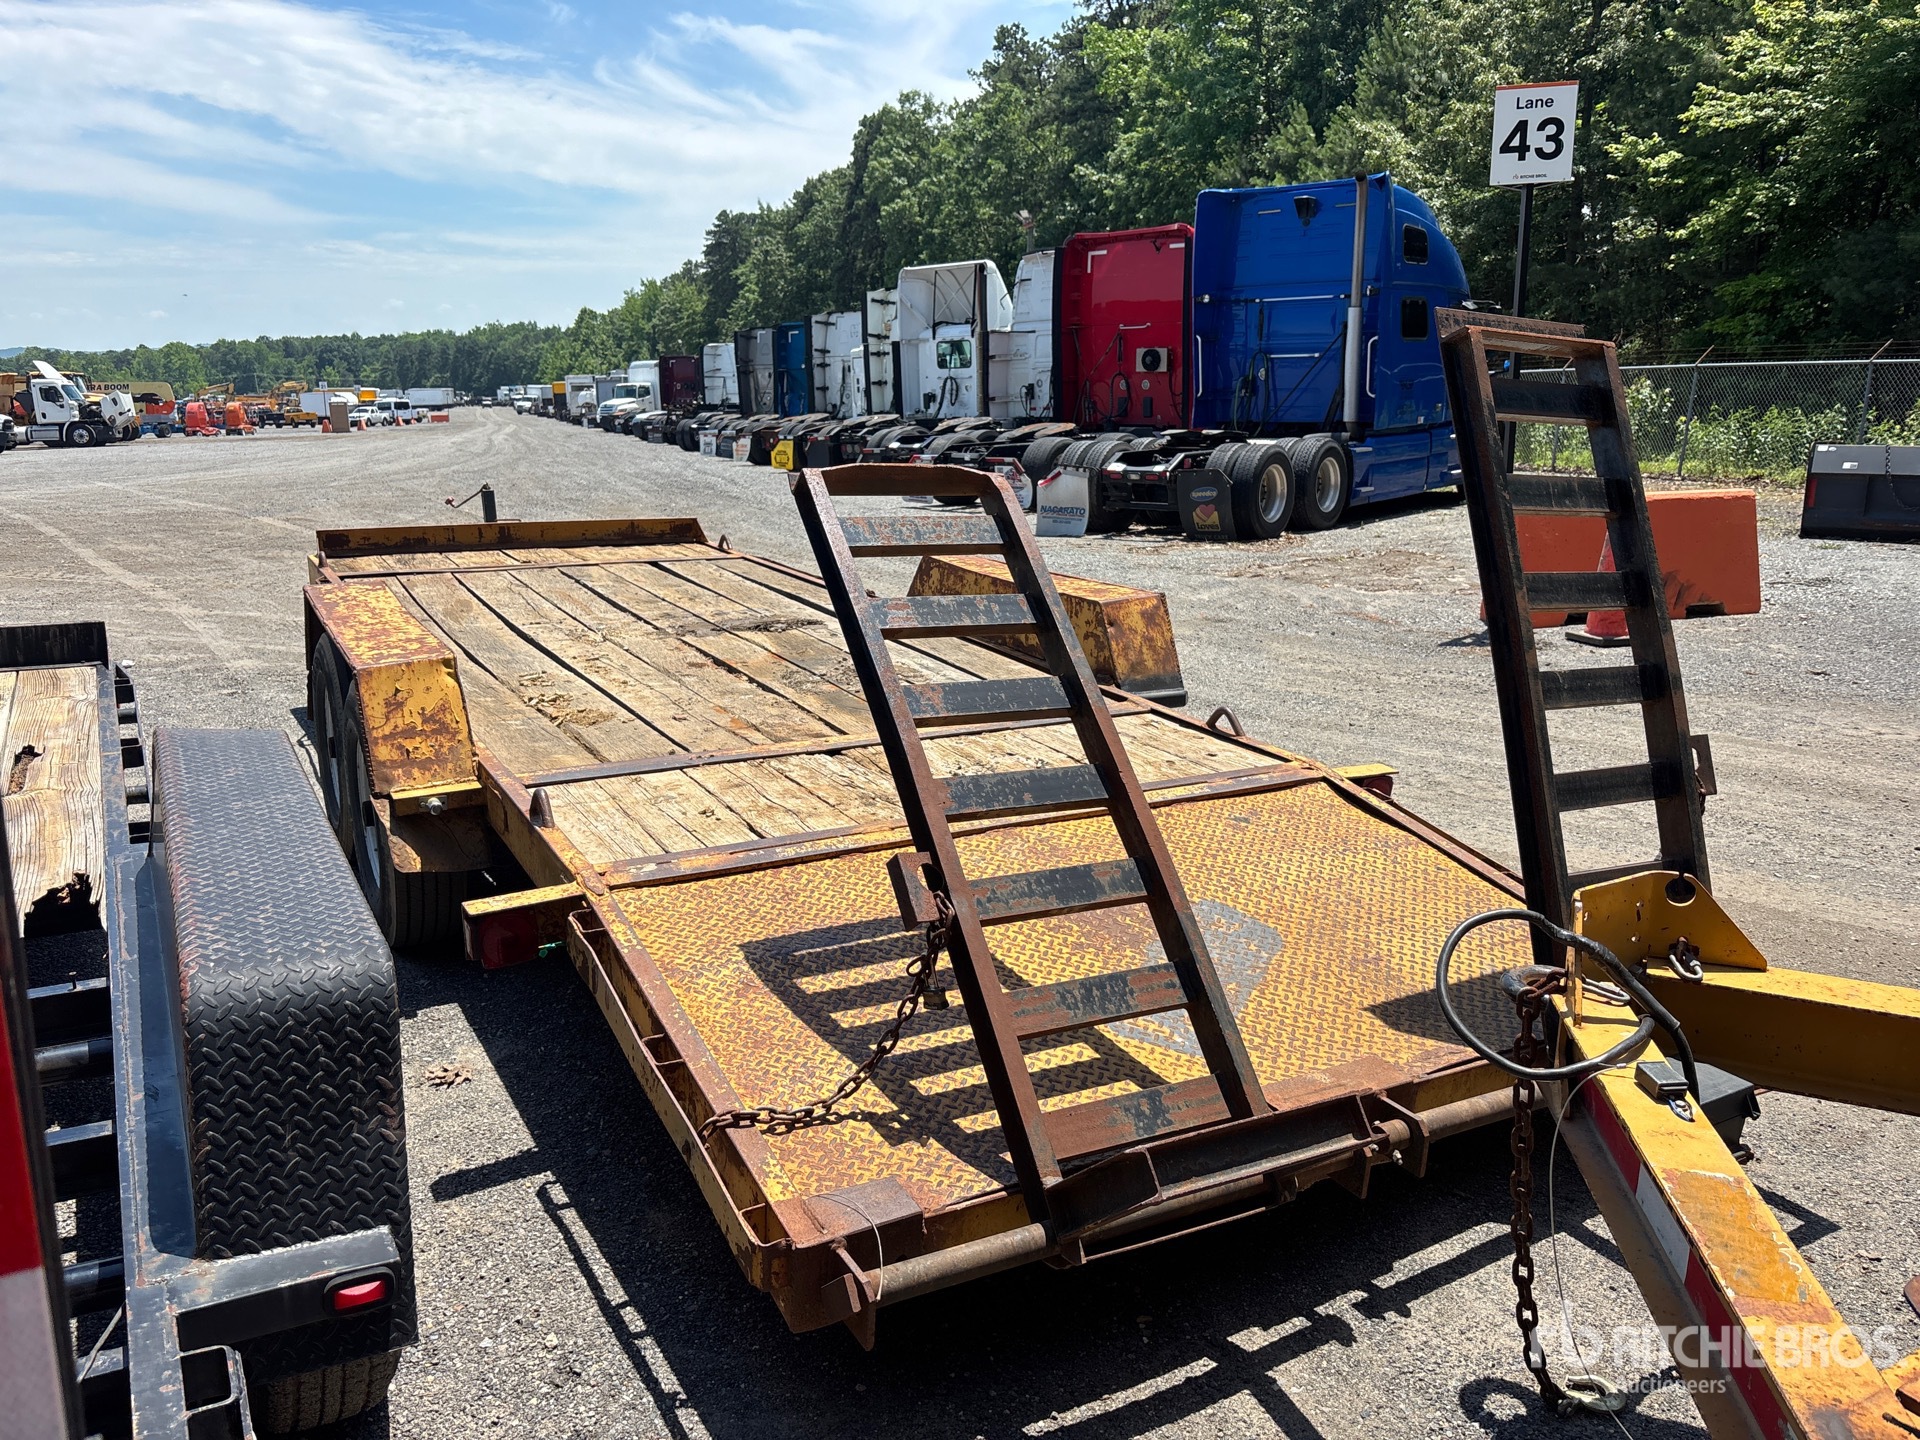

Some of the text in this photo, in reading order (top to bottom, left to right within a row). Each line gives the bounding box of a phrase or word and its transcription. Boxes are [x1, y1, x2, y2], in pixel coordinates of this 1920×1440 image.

[1516, 97, 1554, 110] Lane
[1499, 117, 1565, 161] 43
[104, 383, 130, 391] BOOM
[1040, 505, 1086, 515] NACARATO
